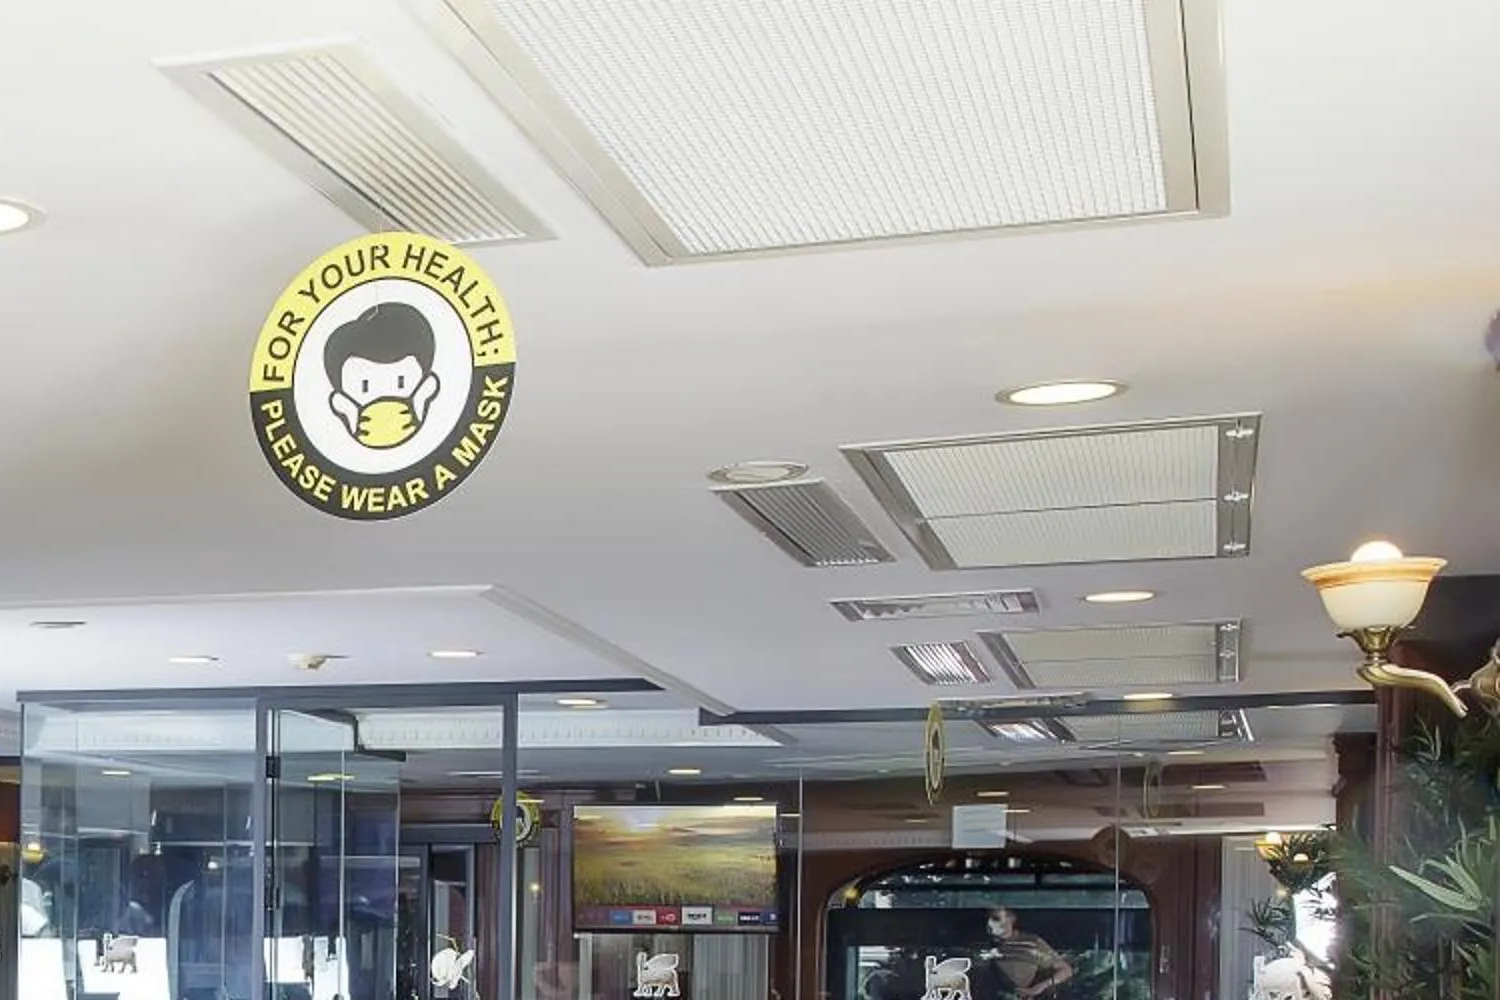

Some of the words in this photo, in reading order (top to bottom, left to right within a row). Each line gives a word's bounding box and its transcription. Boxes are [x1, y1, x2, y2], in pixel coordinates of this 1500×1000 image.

[263, 310, 304, 383] FOR
[298, 244, 391, 305] YOUR
[260, 399, 337, 502] PLEASE
[340, 477, 430, 513] WEAR
[432, 464, 457, 490] A
[451, 375, 510, 468] MASK
